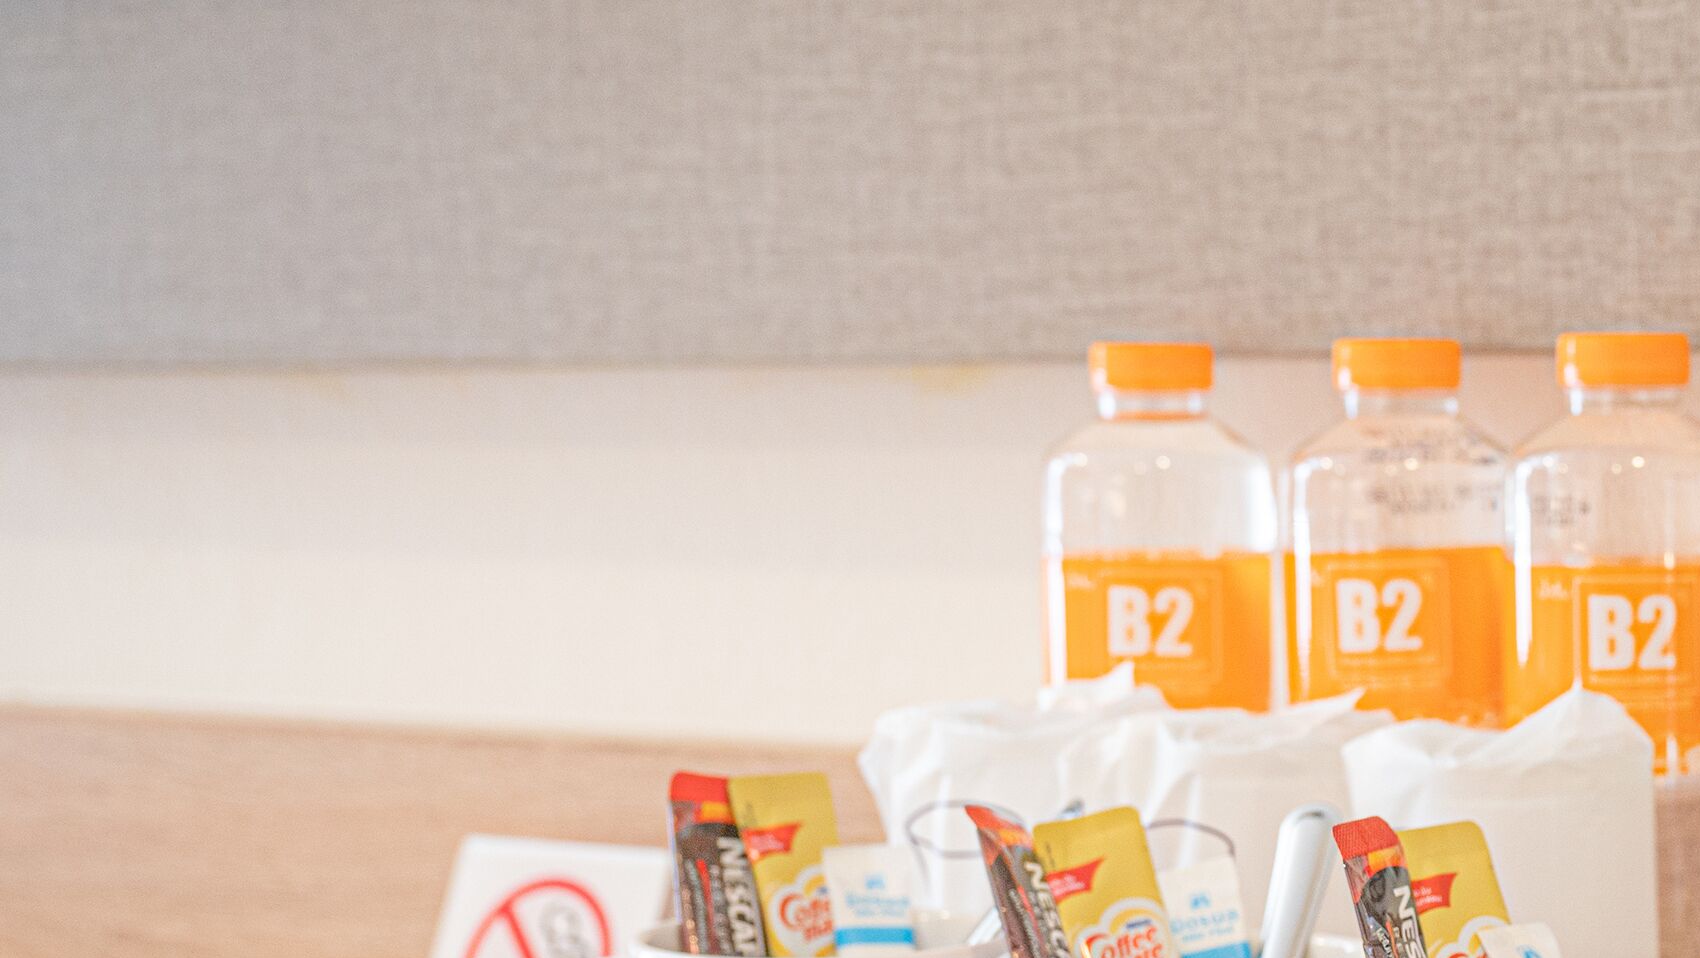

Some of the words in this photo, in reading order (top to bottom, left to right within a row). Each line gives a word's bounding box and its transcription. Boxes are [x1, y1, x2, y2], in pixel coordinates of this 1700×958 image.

[1107, 584, 1194, 657] B2
[1336, 578, 1423, 654] B2
[1588, 594, 1677, 670] B2
